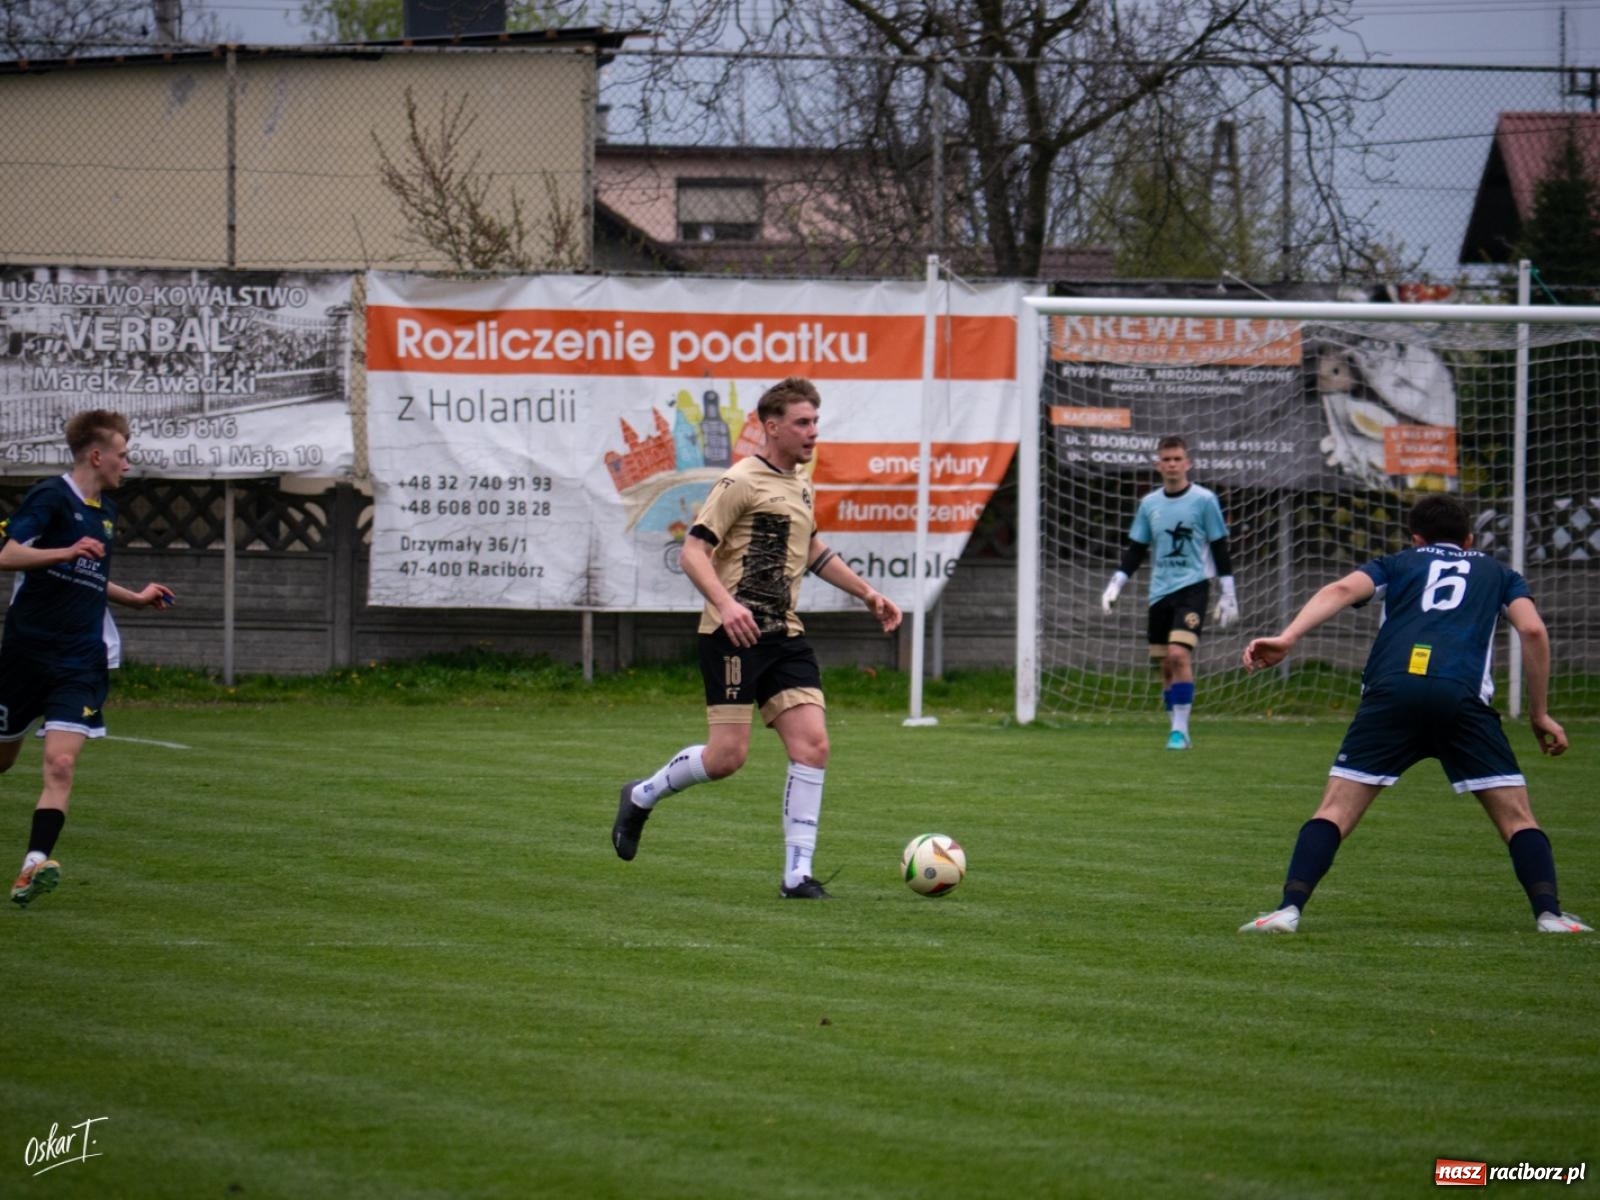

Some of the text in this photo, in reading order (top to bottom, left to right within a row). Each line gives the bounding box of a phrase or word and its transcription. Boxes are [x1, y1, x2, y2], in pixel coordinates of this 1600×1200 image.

[396, 318, 868, 371] Rozliczenie podatku
[34, 367, 256, 395] Marek Zawadzki
[396, 388, 576, 423] z Holandii
[151, 417, 188, 438] 165
[196, 417, 237, 439] 816
[174, 444, 203, 466] ul.
[211, 446, 221, 467] 1
[230, 445, 288, 472] Maja
[295, 445, 323, 466] 10
[398, 475, 553, 492] +48 32 740 91 93
[400, 499, 551, 516] +48 608 00 38 28
[400, 535, 527, 555] Drzymały 36/1
[399, 561, 545, 578] 47-400 Racibórz
[1421, 559, 1471, 613] 6
[723, 655, 742, 687] 18
